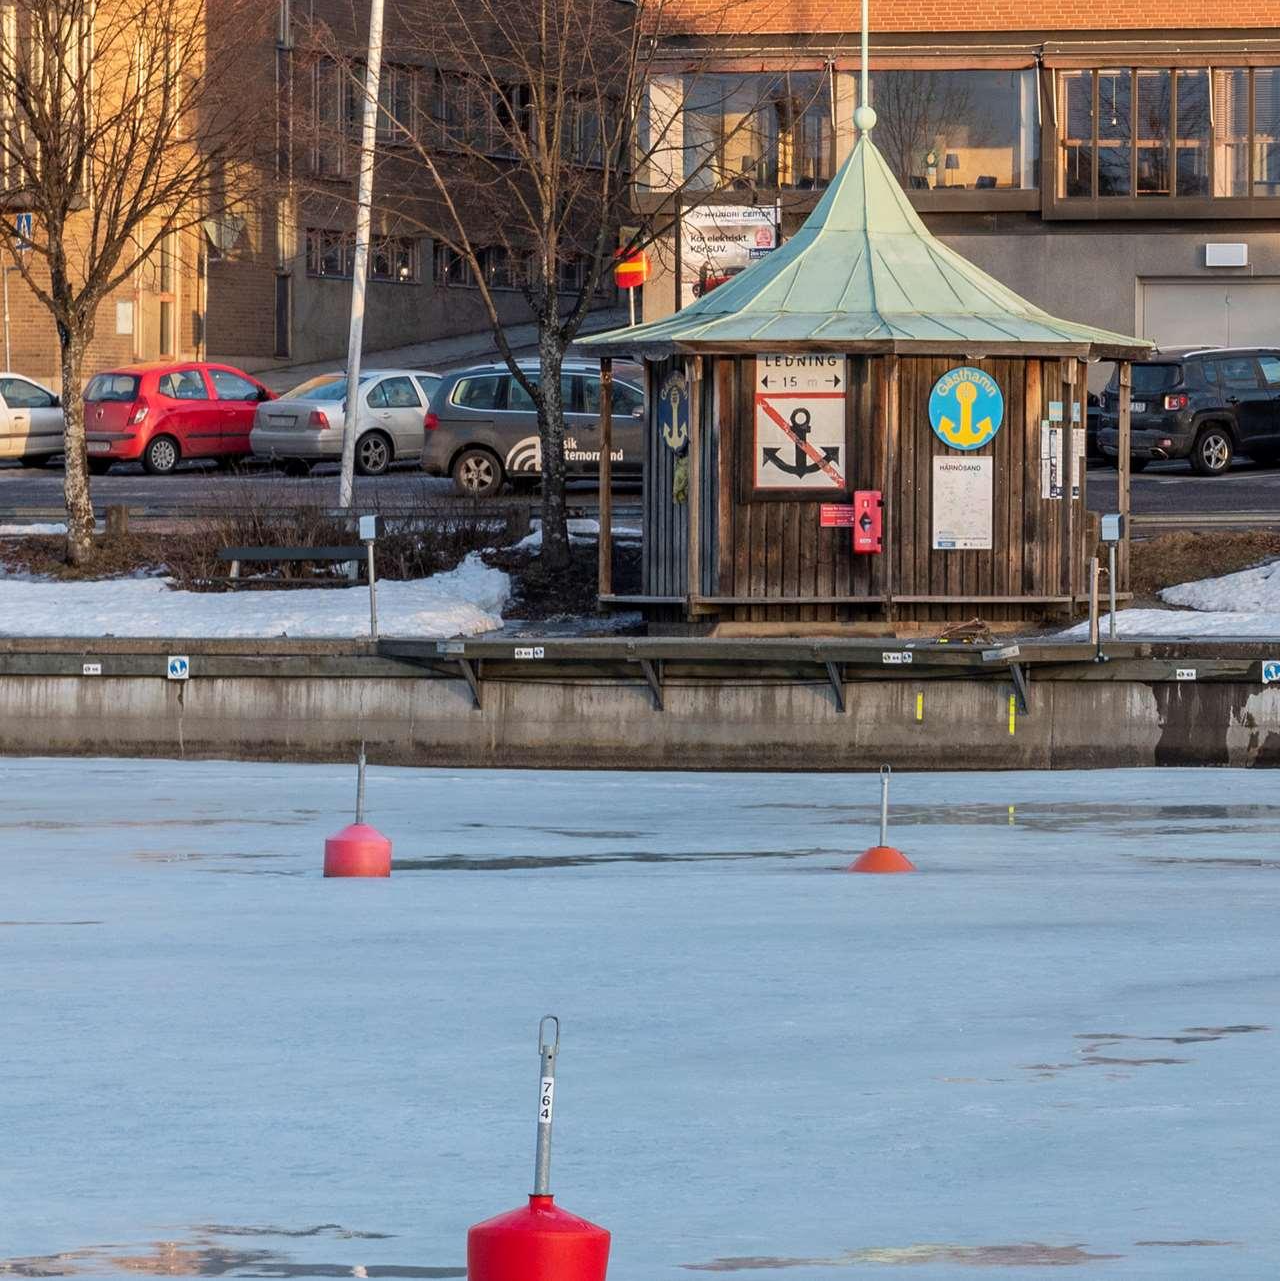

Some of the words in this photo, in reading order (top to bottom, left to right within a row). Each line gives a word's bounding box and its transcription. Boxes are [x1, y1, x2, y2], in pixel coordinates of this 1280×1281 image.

[765, 355, 837, 367] LEDNING
[783, 376, 798, 388] 15
[540, 1082, 552, 1119] 764
